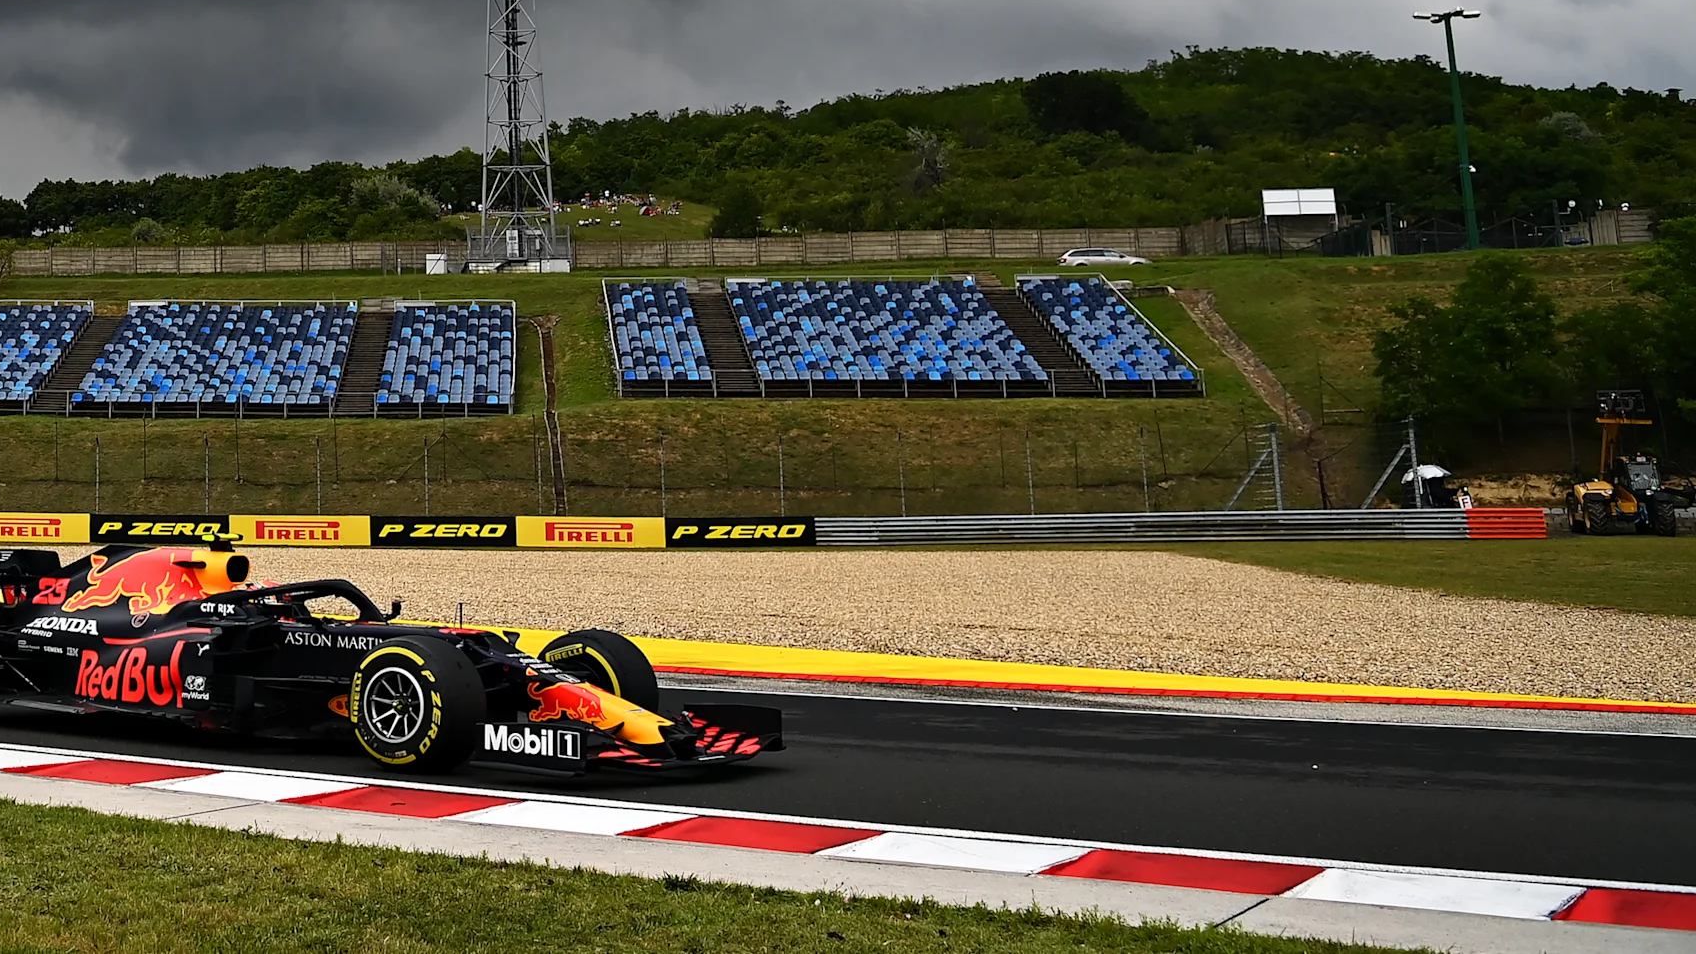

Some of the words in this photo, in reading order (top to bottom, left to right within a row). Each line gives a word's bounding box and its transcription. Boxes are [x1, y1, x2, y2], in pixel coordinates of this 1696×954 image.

[98, 522, 122, 535] P
[128, 523, 221, 536] ZERO
[255, 520, 340, 540] PIRELLI
[379, 524, 405, 537] P
[409, 524, 508, 538] ZERO
[545, 522, 633, 542] PIRELLI
[672, 525, 699, 539] P
[704, 525, 806, 539] ZERO
[32, 577, 71, 605] 23
[21, 628, 52, 638] HYBRID
[26, 616, 99, 635] HONDA
[284, 632, 332, 648] ASTON
[545, 643, 584, 662] PIRELLI
[181, 692, 209, 701] myWorld
[350, 672, 362, 724] PIRELLI
[419, 690, 442, 754] ZERO
[484, 724, 553, 756] Mobil
